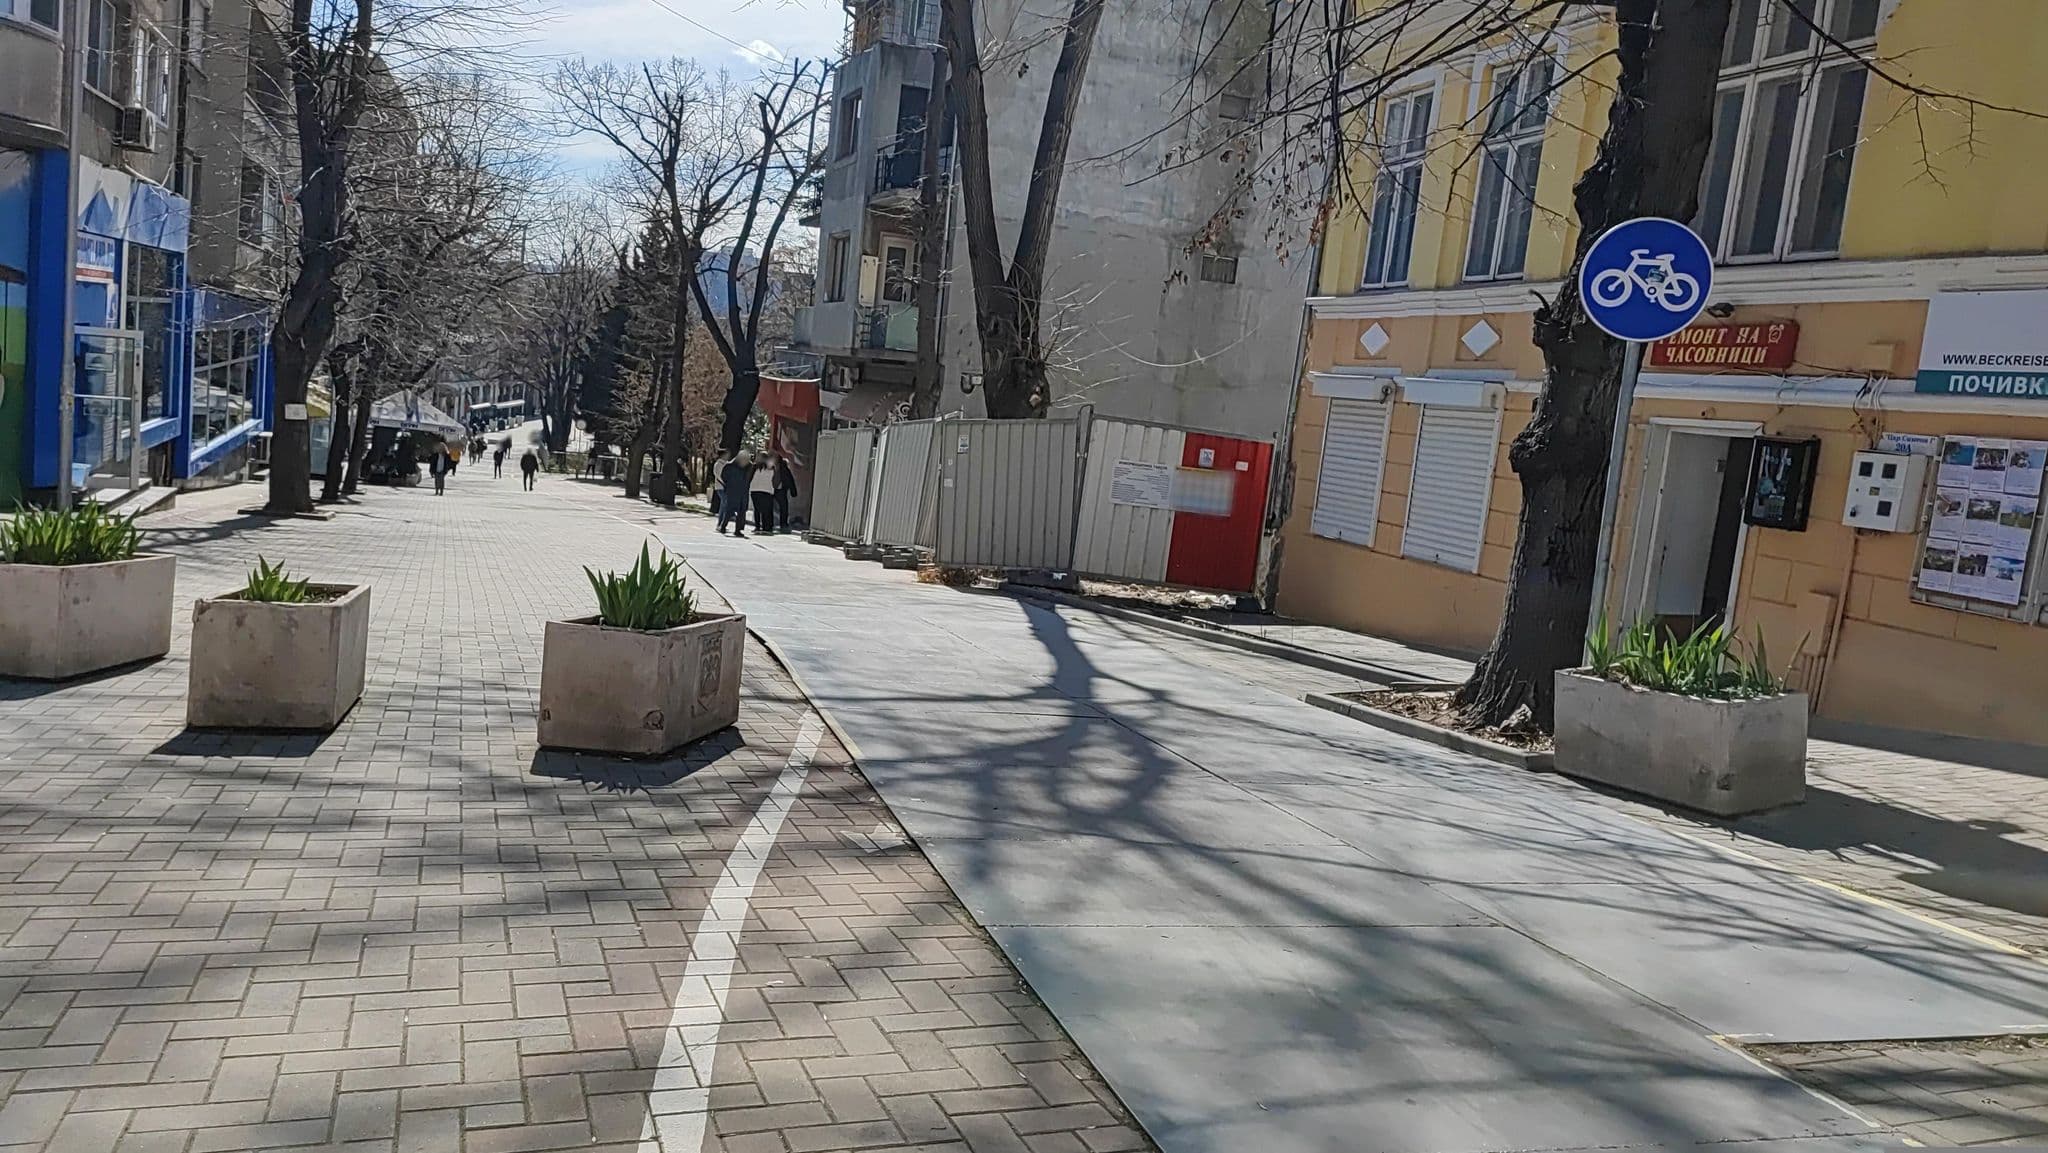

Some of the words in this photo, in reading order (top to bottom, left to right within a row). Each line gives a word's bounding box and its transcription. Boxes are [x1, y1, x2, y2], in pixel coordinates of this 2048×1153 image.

[1736, 327, 1760, 344] НА
[1666, 346, 1768, 365] ЧАСОВНИЦИ
[1949, 375, 2048, 394] ПОЧИВК
